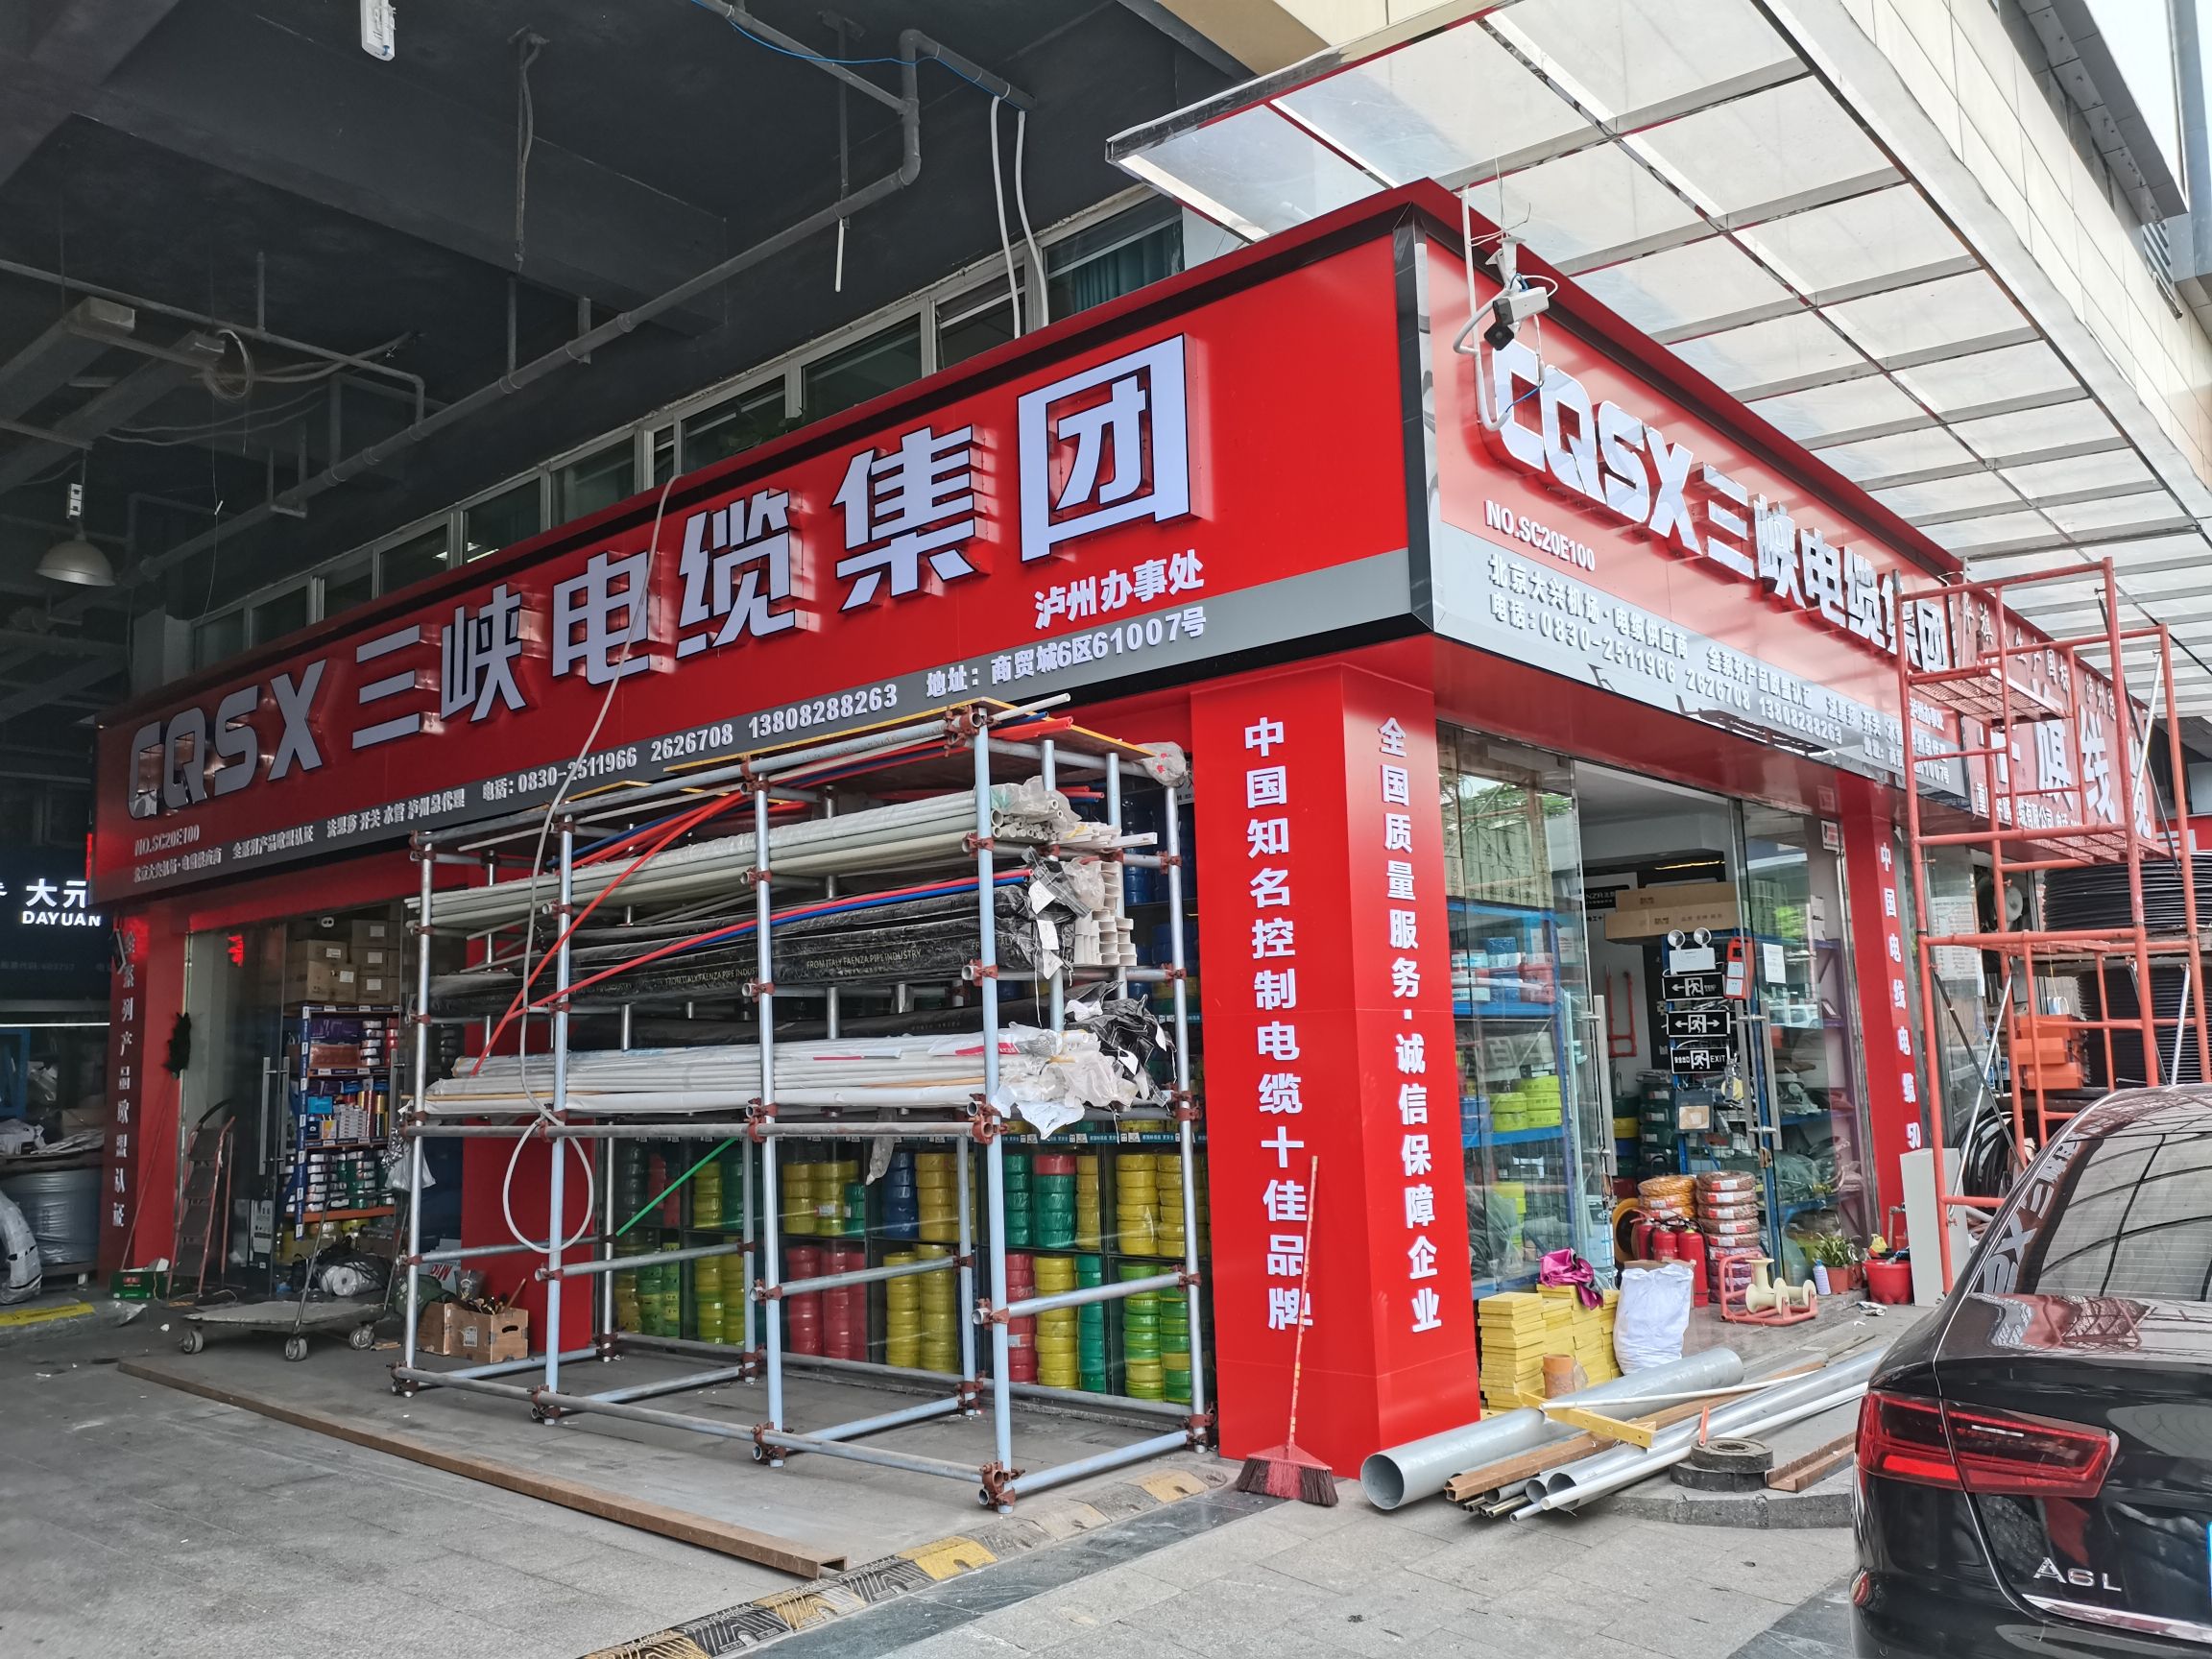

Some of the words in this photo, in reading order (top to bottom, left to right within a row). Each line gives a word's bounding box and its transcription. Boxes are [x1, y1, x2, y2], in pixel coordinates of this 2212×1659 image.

[1485, 500, 1596, 571] NO.SC20E100
[1034, 549, 1204, 630] 泸州办事处
[650, 723, 733, 763] 2626708
[748, 683, 898, 739] 13808288263
[1685, 668, 1750, 710] 2626708
[1759, 697, 1842, 745] 13808288263
[407, 787, 466, 820] 泸州总代理
[22, 911, 101, 926] DAYUAN
[806, 960, 825, 970] FROM
[826, 958, 842, 968] ITALY
[843, 954, 869, 965] FAENZA
[870, 952, 884, 963] PIPE
[884, 949, 922, 961] INDUSTRY
[1244, 717, 1313, 1331] 中国知名控制电缆十佳品牌
[1710, 1054, 1726, 1063] EXIT
[2033, 1556, 2123, 1593] A6L
